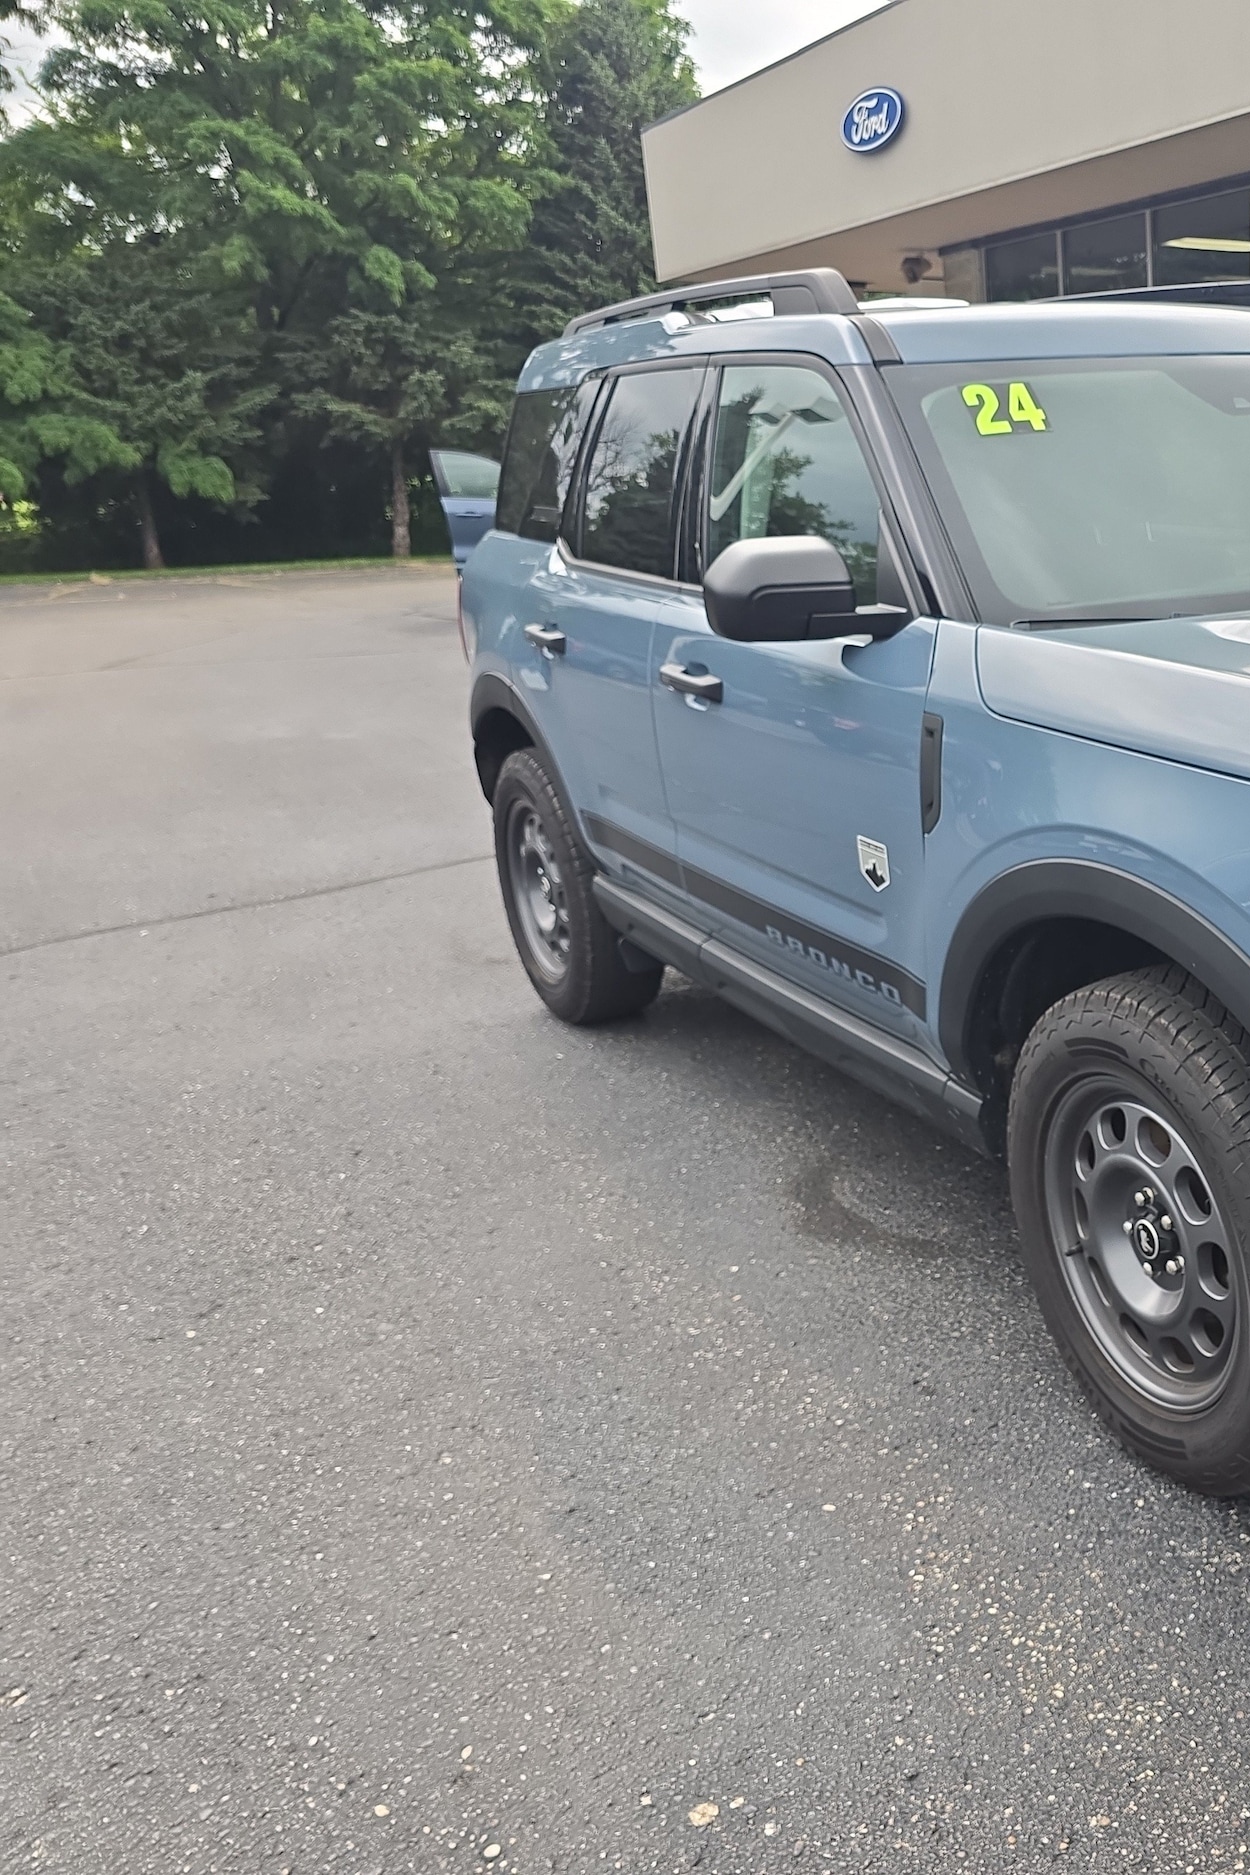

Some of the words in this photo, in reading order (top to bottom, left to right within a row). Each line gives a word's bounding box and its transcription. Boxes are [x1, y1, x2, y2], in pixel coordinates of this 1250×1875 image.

[851, 96, 890, 144] Ford
[961, 382, 1047, 435] 24
[765, 924, 903, 1007] BRONCO
